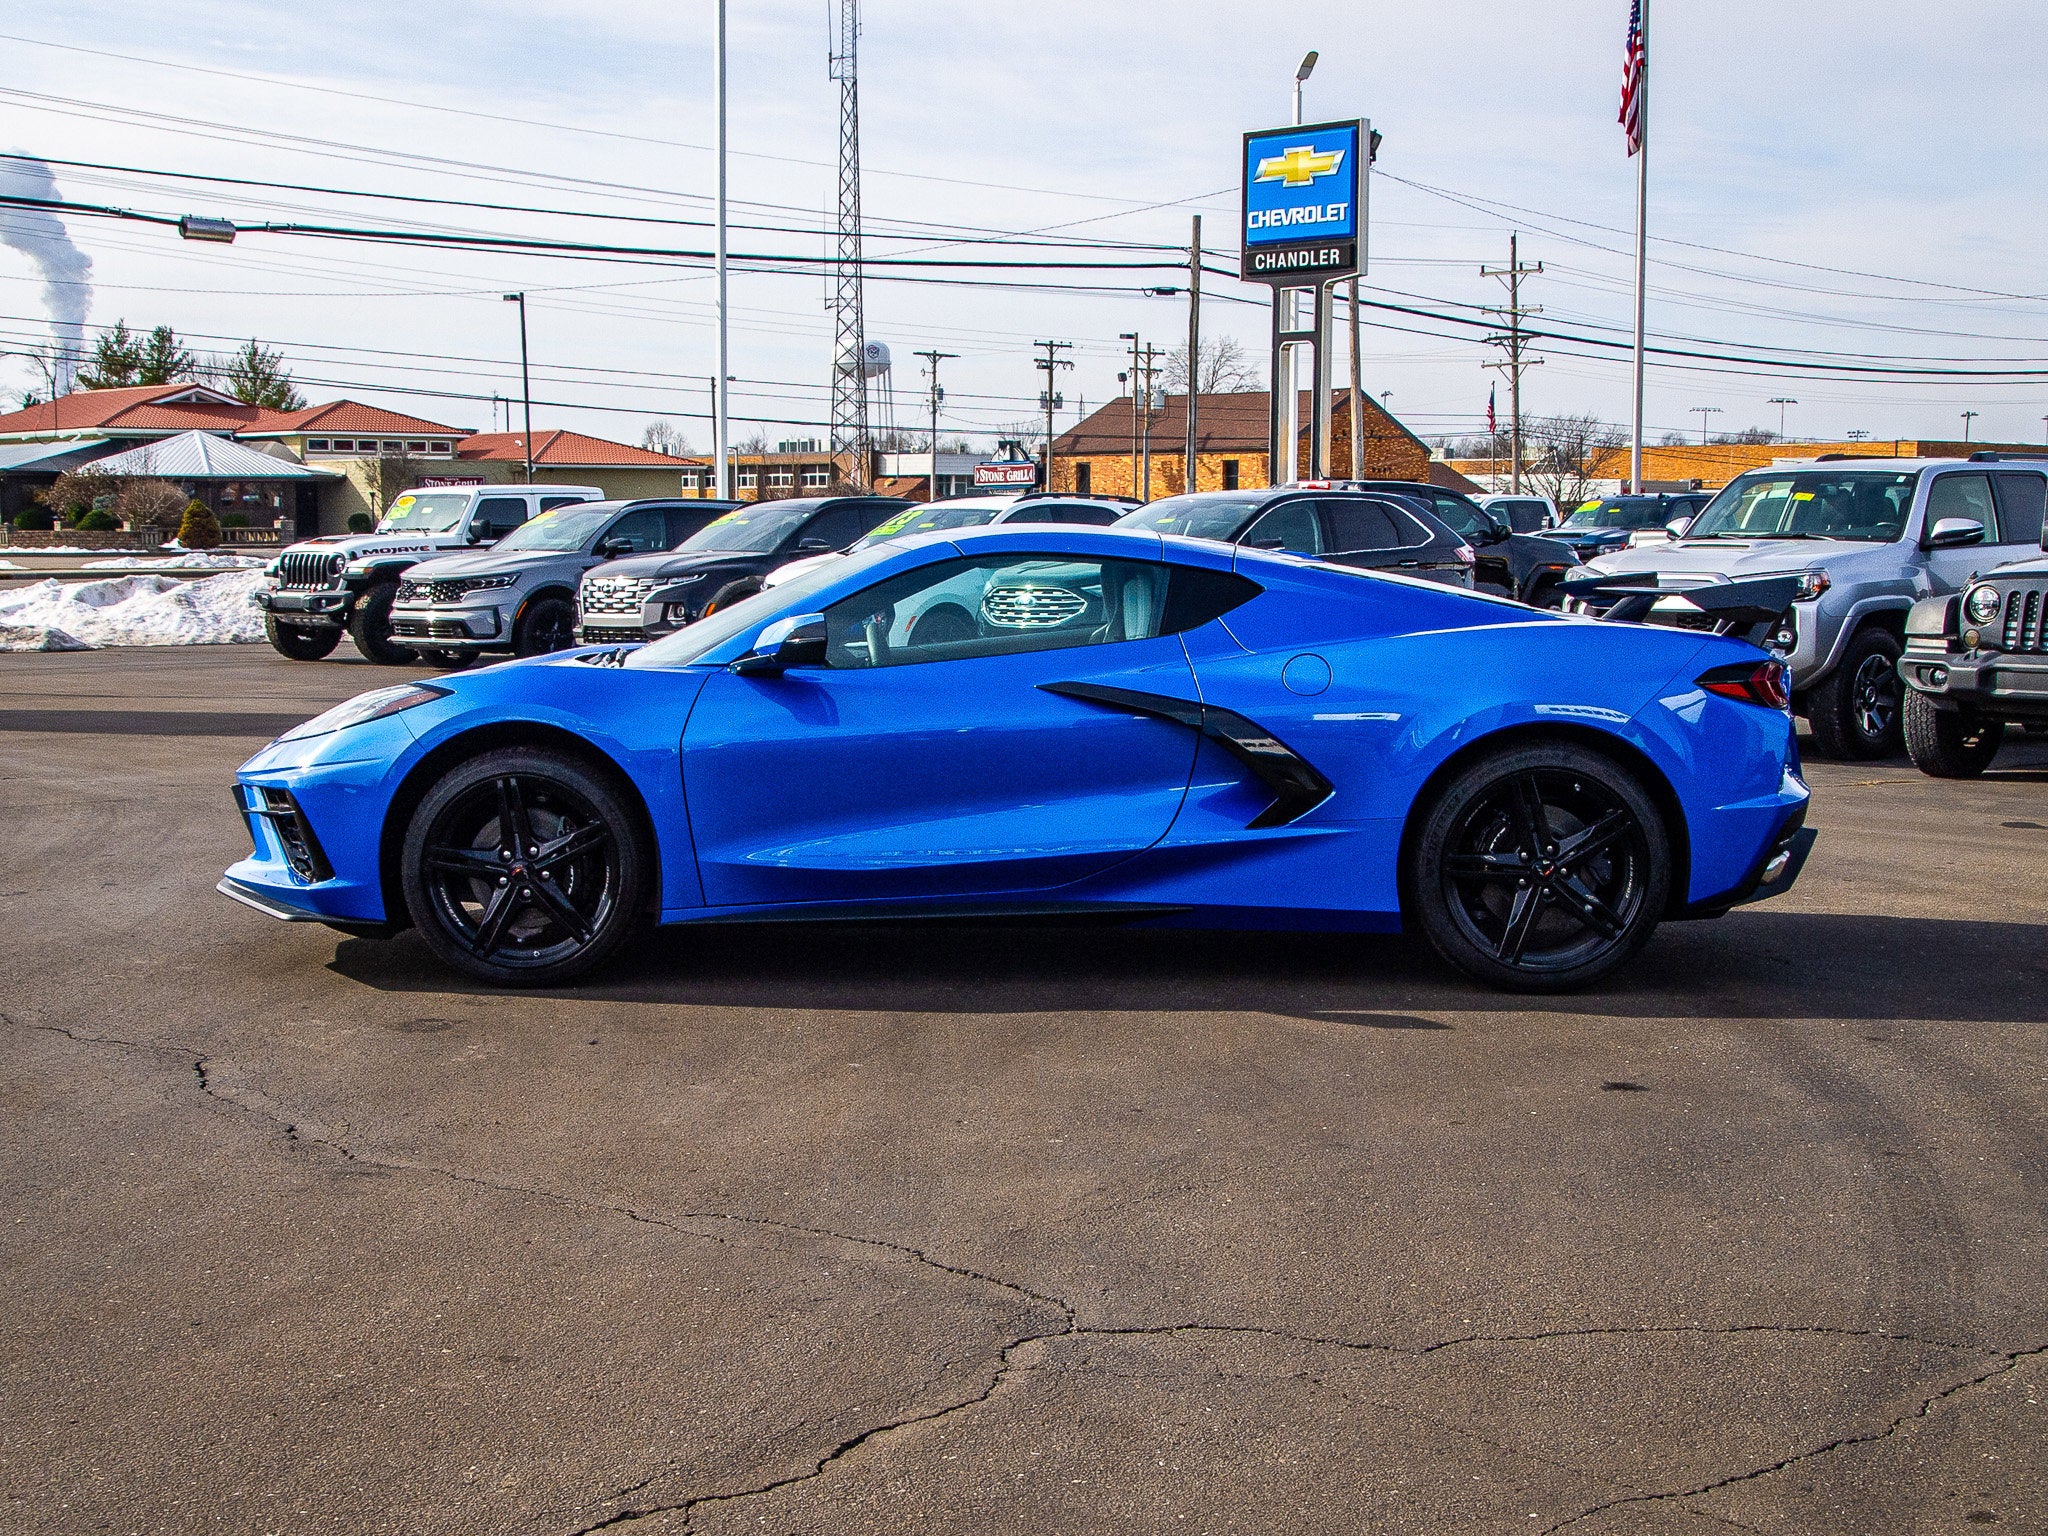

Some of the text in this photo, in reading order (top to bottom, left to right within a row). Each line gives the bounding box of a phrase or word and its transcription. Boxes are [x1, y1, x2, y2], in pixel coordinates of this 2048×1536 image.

[1248, 203, 1349, 229] CHEVROLET
[1255, 249, 1340, 269] CHANDLER
[980, 468, 1030, 482] STONE GRILL
[362, 545, 430, 555] MOJAVE
